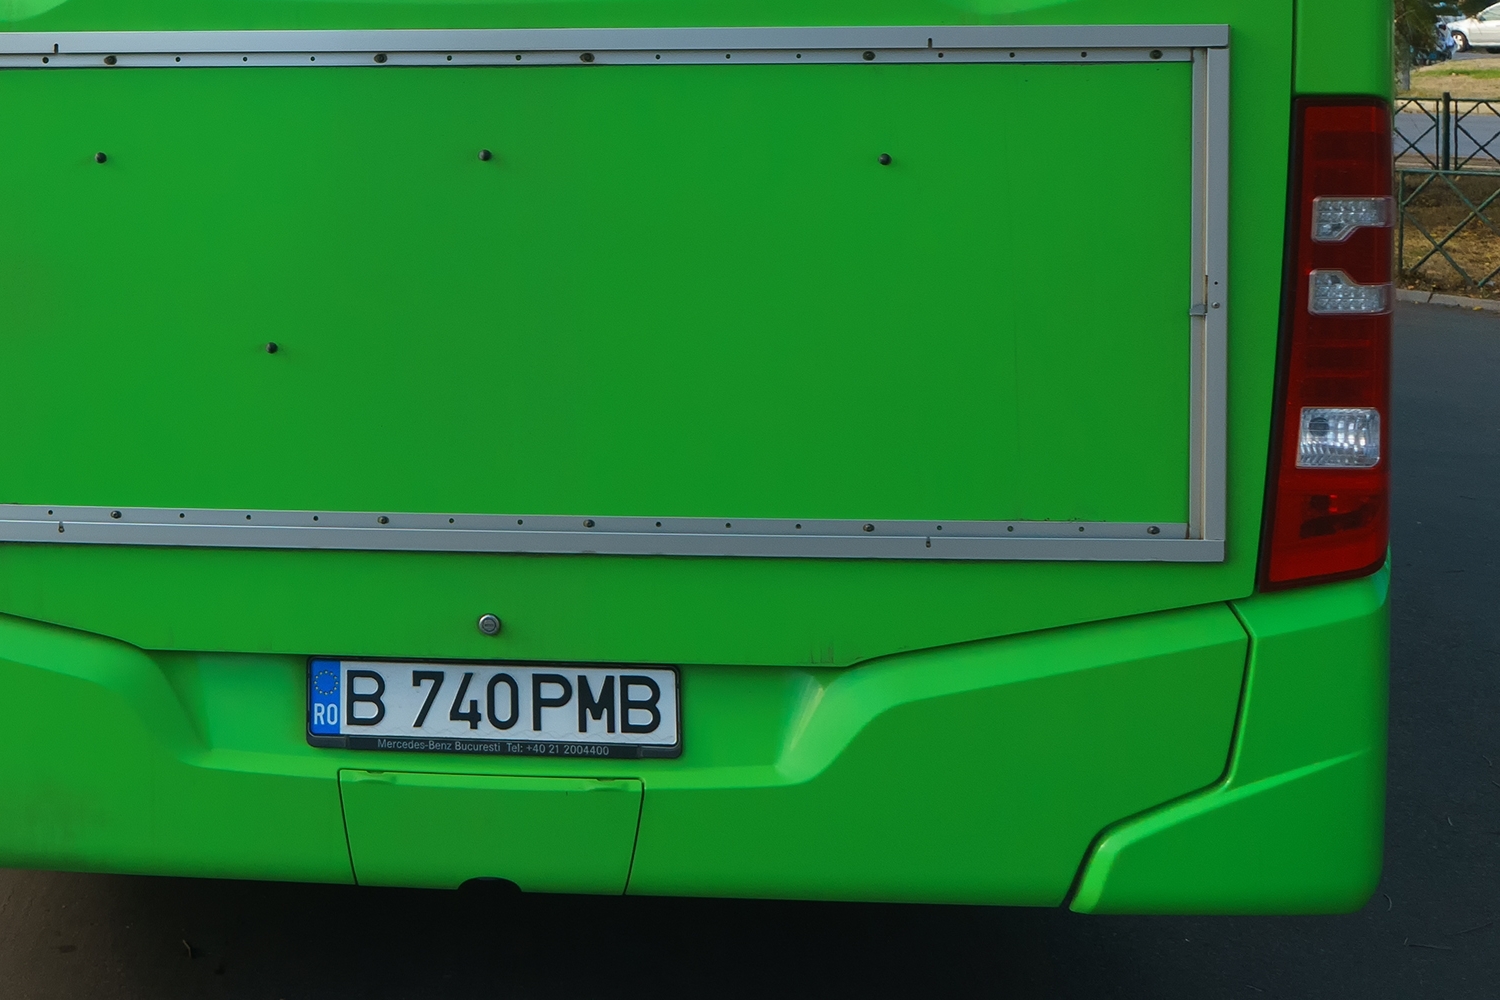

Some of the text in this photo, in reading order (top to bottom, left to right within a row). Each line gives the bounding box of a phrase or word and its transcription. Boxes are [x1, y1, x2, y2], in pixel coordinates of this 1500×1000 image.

[346, 669, 386, 726] B
[313, 702, 339, 726] RO
[377, 738, 610, 756] Mercedes-Benz Bucuresti Tel: +40 21 2004400
